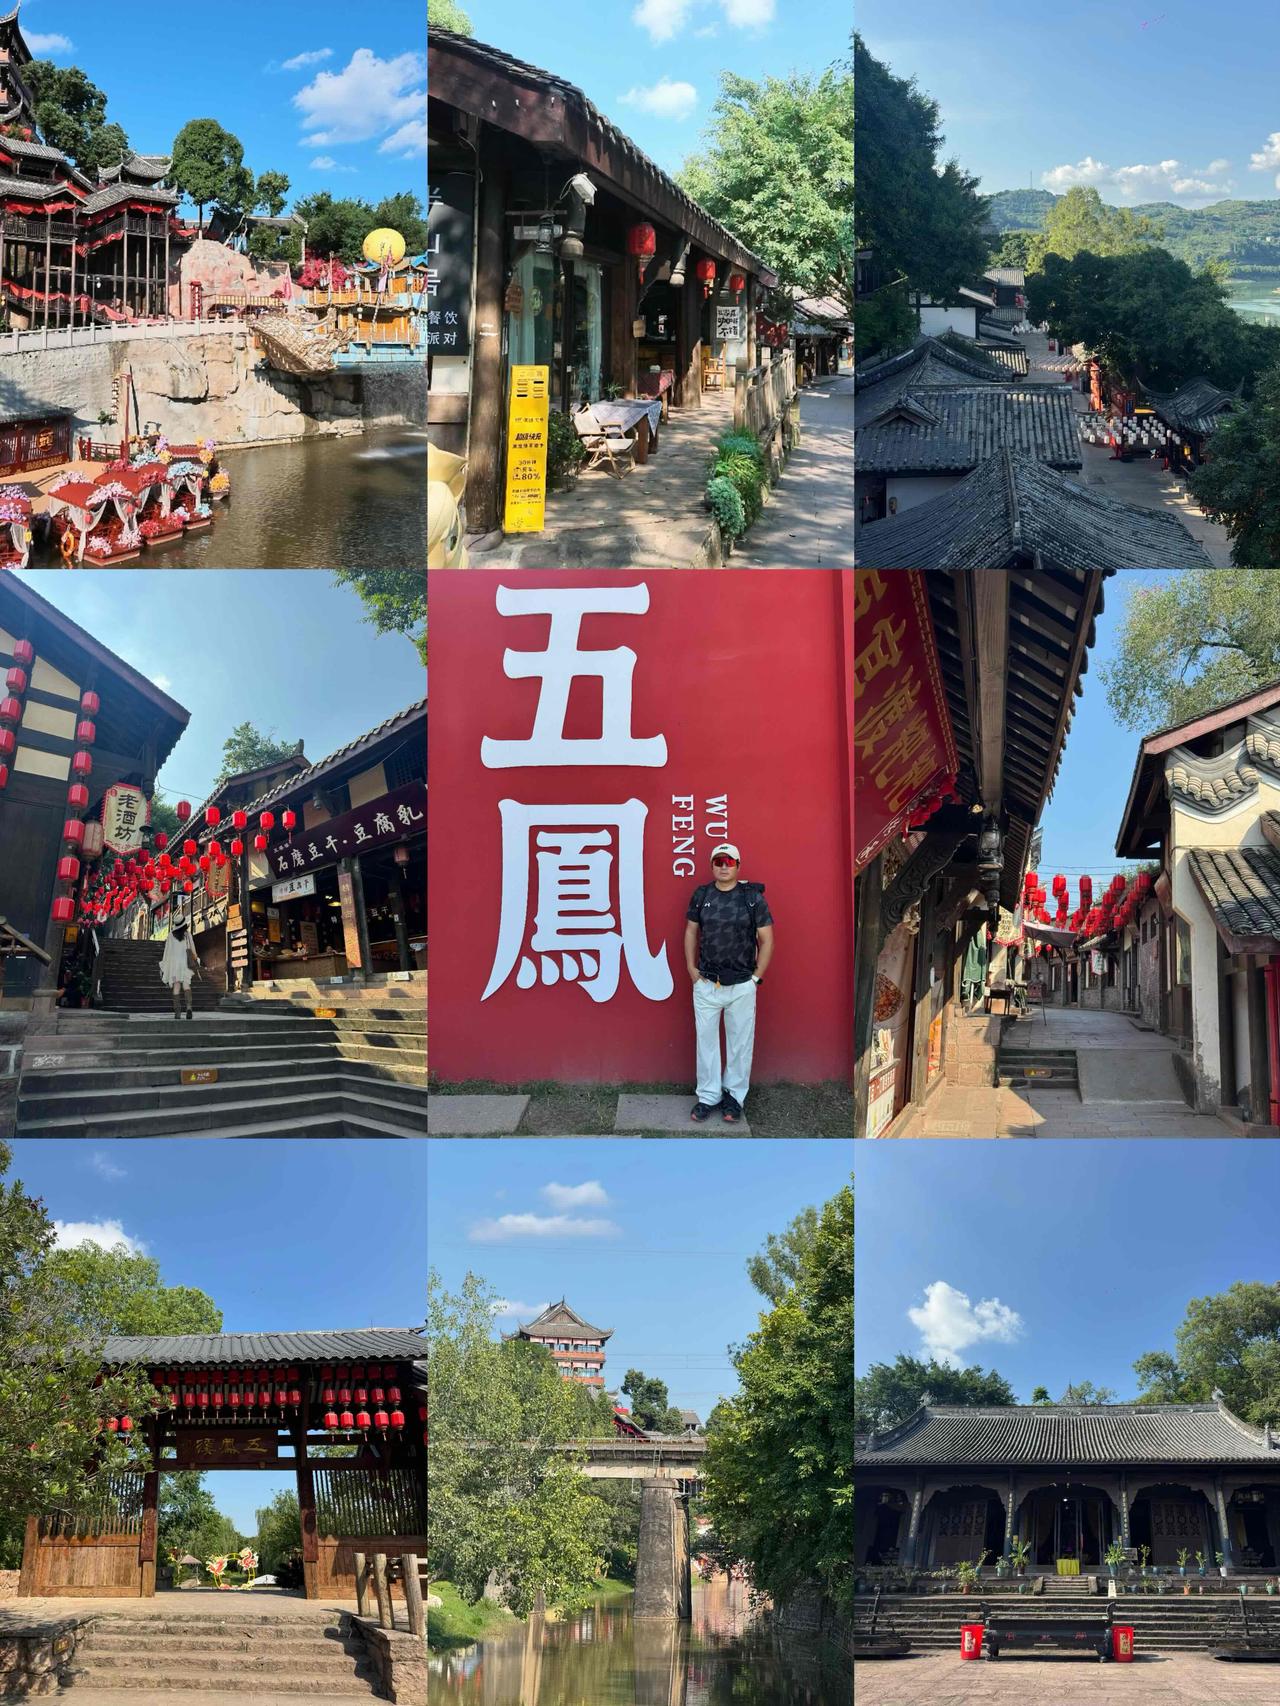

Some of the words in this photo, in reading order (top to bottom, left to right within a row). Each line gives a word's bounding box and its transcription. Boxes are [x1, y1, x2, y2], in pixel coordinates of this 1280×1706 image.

[427, 331, 457, 346] 派对
[428, 311, 458, 325] 餐饮
[114, 794, 139, 841] 老酒坊
[672, 794, 696, 877] FENG
[705, 793, 728, 839] WU
